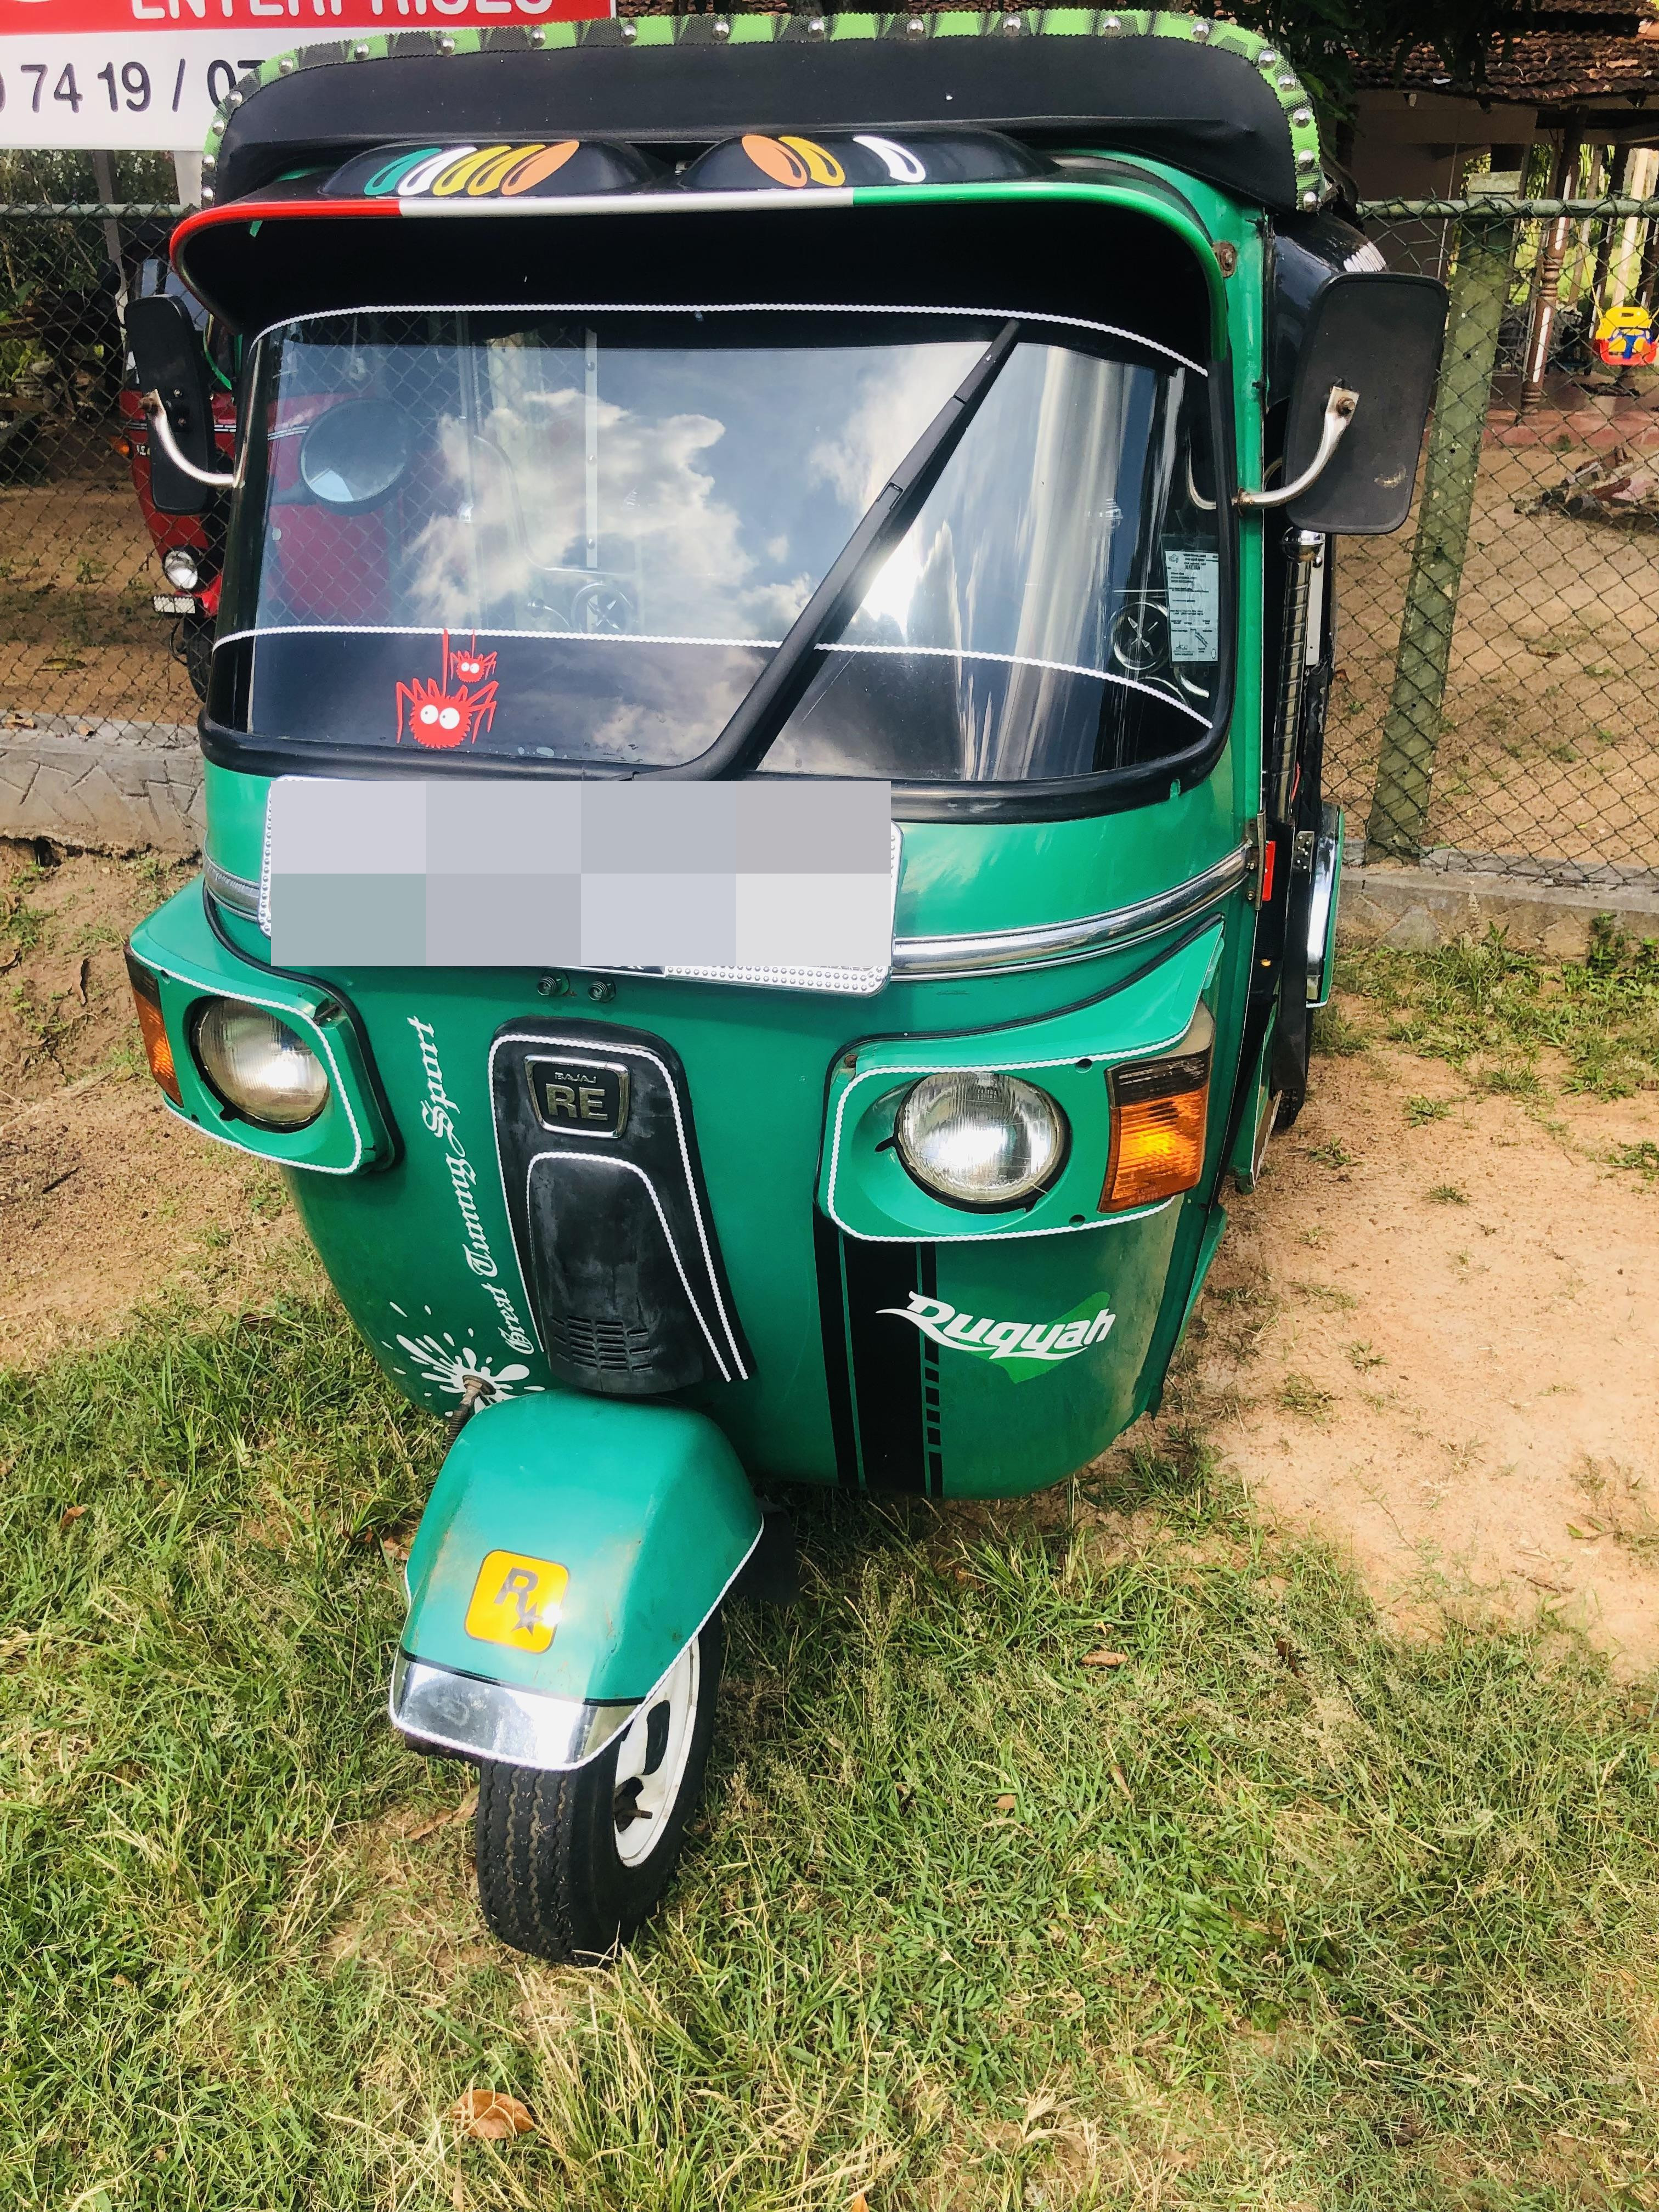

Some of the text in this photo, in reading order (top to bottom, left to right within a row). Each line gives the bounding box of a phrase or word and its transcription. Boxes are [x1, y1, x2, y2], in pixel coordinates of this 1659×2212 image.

[21, 63, 83, 113] 74
[97, 61, 151, 112] 19
[555, 1071, 597, 1084] BAJAJ
[546, 1083, 609, 1121] RE
[407, 1016, 534, 1355] Great Tuning Sport
